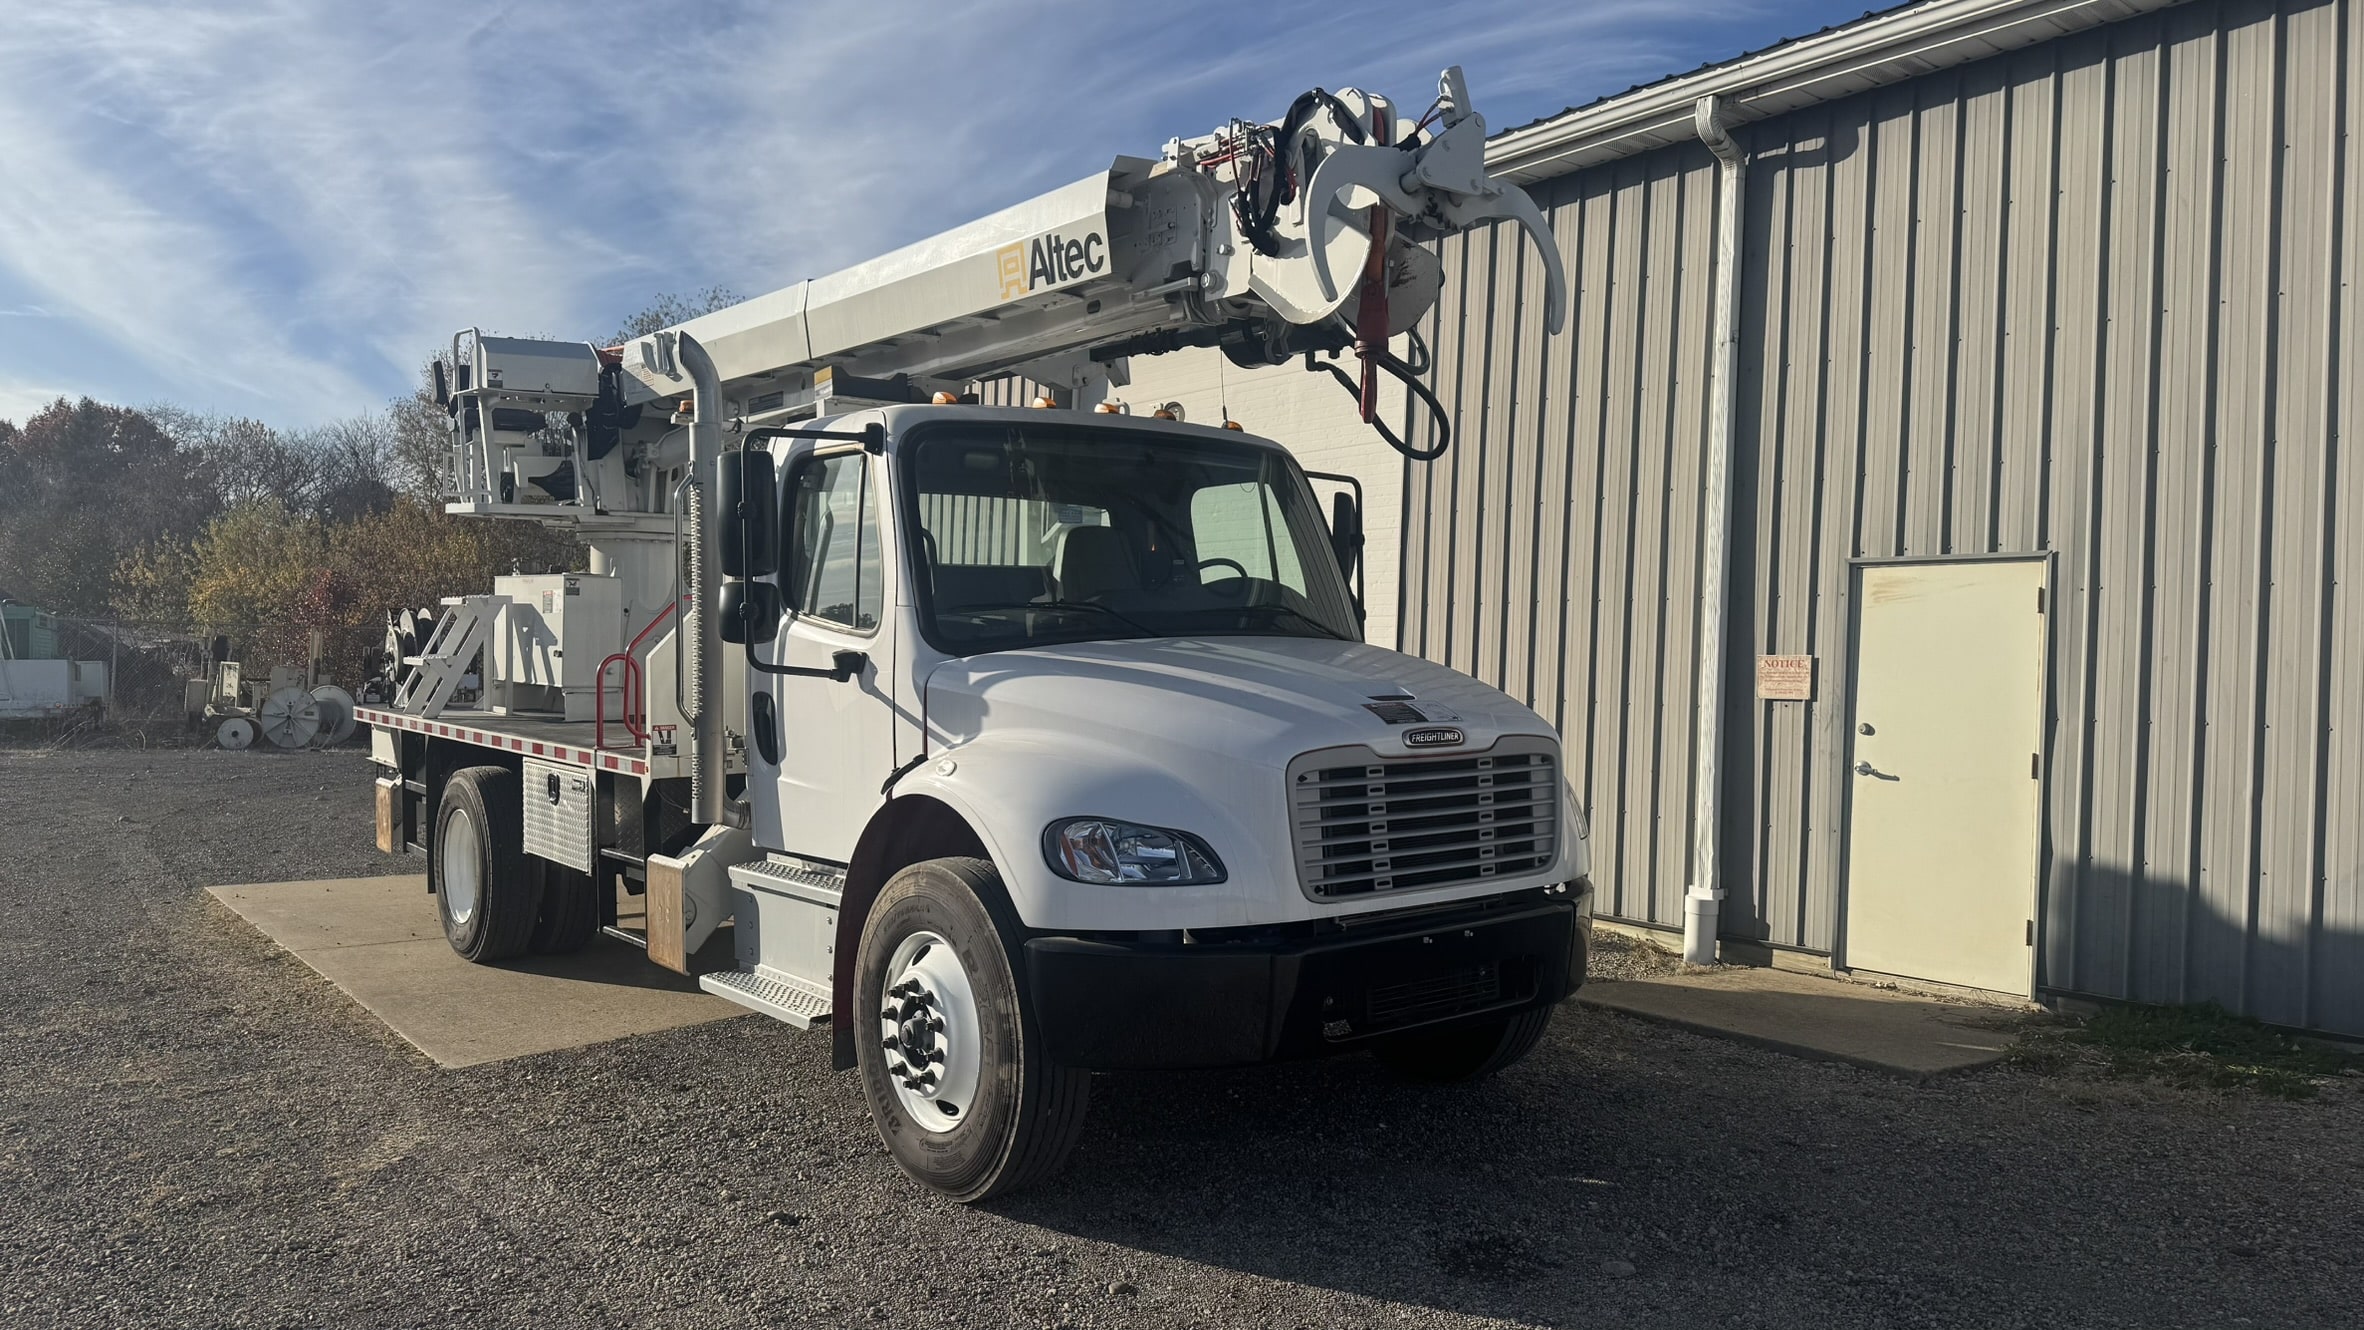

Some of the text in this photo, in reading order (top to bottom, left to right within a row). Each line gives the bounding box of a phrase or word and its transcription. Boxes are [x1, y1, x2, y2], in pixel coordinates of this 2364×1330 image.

[1029, 232, 1104, 291] Altec
[1764, 659, 1805, 668] NOTICE
[1411, 732, 1459, 743] FREIGHTLINER
